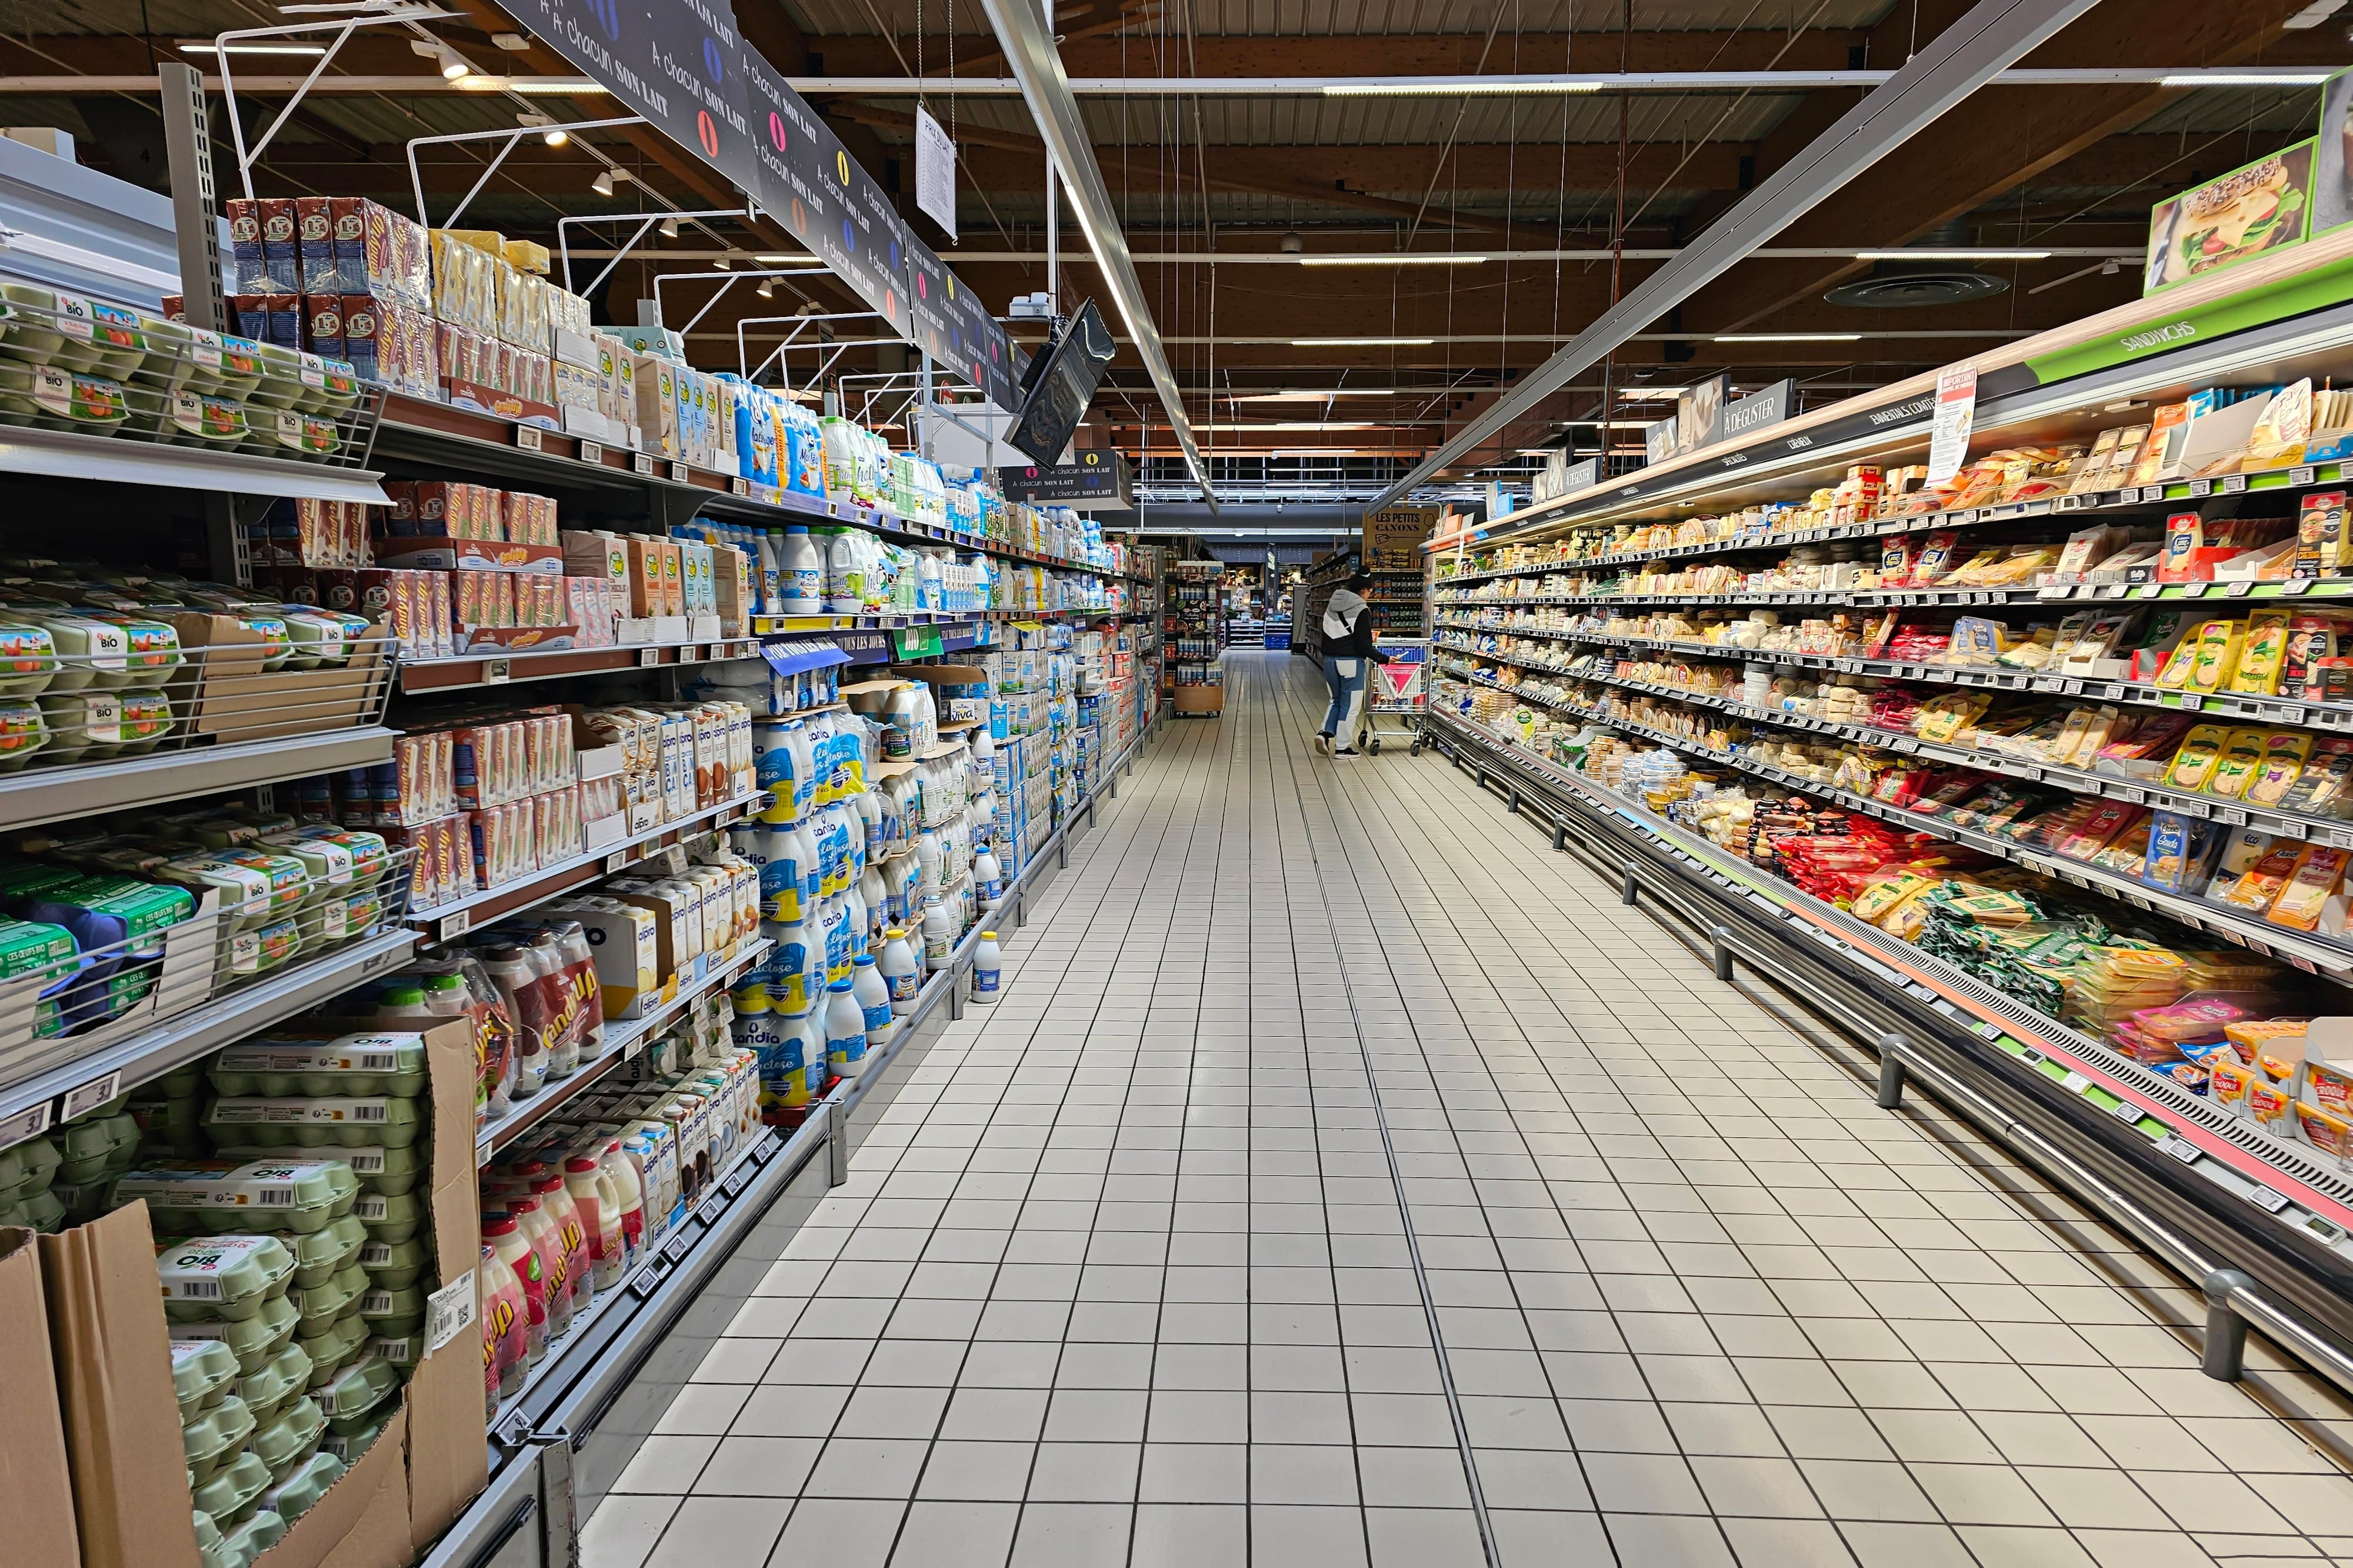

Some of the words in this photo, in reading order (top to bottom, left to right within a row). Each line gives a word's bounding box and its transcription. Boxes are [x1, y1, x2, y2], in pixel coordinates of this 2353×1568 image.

[554, 12, 562, 34] A
[567, 17, 613, 76] chacun
[615, 59, 641, 96] SON
[641, 81, 668, 118] LAIT
[652, 41, 661, 68] A
[664, 52, 703, 101] chacun
[704, 86, 725, 118] SON
[726, 105, 746, 135] LAIT
[743, 54, 749, 76] A
[752, 65, 781, 108] chacun
[783, 98, 799, 126] SON
[799, 115, 816, 144] LAIT
[925, 120, 936, 139] PRIX
[761, 144, 789, 184] chacun
[791, 172, 807, 199] SON
[807, 186, 823, 215] LAIT
[818, 164, 822, 184] A
[824, 172, 845, 208] chacun
[845, 197, 857, 220] SON
[857, 209, 870, 233] LAIT
[824, 234, 828, 253] A
[830, 241, 850, 275] chacun
[851, 263, 862, 288] SON
[862, 274, 875, 296] LAIT
[66, 304, 84, 317] BIO
[2121, 321, 2195, 352] SANDWICHS
[1943, 371, 1975, 386] IMPORTANT
[1724, 414, 1730, 435] À
[1731, 397, 1774, 431] DÉGUSTER
[1567, 475, 1570, 487] À
[1570, 468, 1590, 486] DÉGUSTER
[1376, 513, 1391, 522] LES
[1392, 513, 1420, 523] PETITS
[101, 638, 118, 648] BIO
[856, 635, 867, 649] LES
[869, 635, 885, 649] JOURS
[905, 628, 919, 650] BIO
[96, 708, 112, 718] BIO
[635, 817, 648, 830] alpro
[2158, 836, 2178, 849] Gouda
[334, 858, 346, 867] BIO
[251, 885, 264, 896] BIO
[719, 884, 731, 898] alpro
[704, 892, 716, 905] alpro
[688, 899, 701, 913] alpro
[638, 926, 654, 941] alpro
[7, 952, 18, 961] CES
[36, 945, 45, 954] BIO
[709, 955, 721, 966] alpro
[679, 973, 692, 986] alpro
[644, 997, 658, 1010] alpro
[733, 1032, 779, 1044] candia
[758, 1059, 794, 1069] actose
[660, 1139, 674, 1157] alpro
[644, 1155, 658, 1173] alpro
[655, 1224, 667, 1240] alpro
[176, 1255, 222, 1266] BIO
